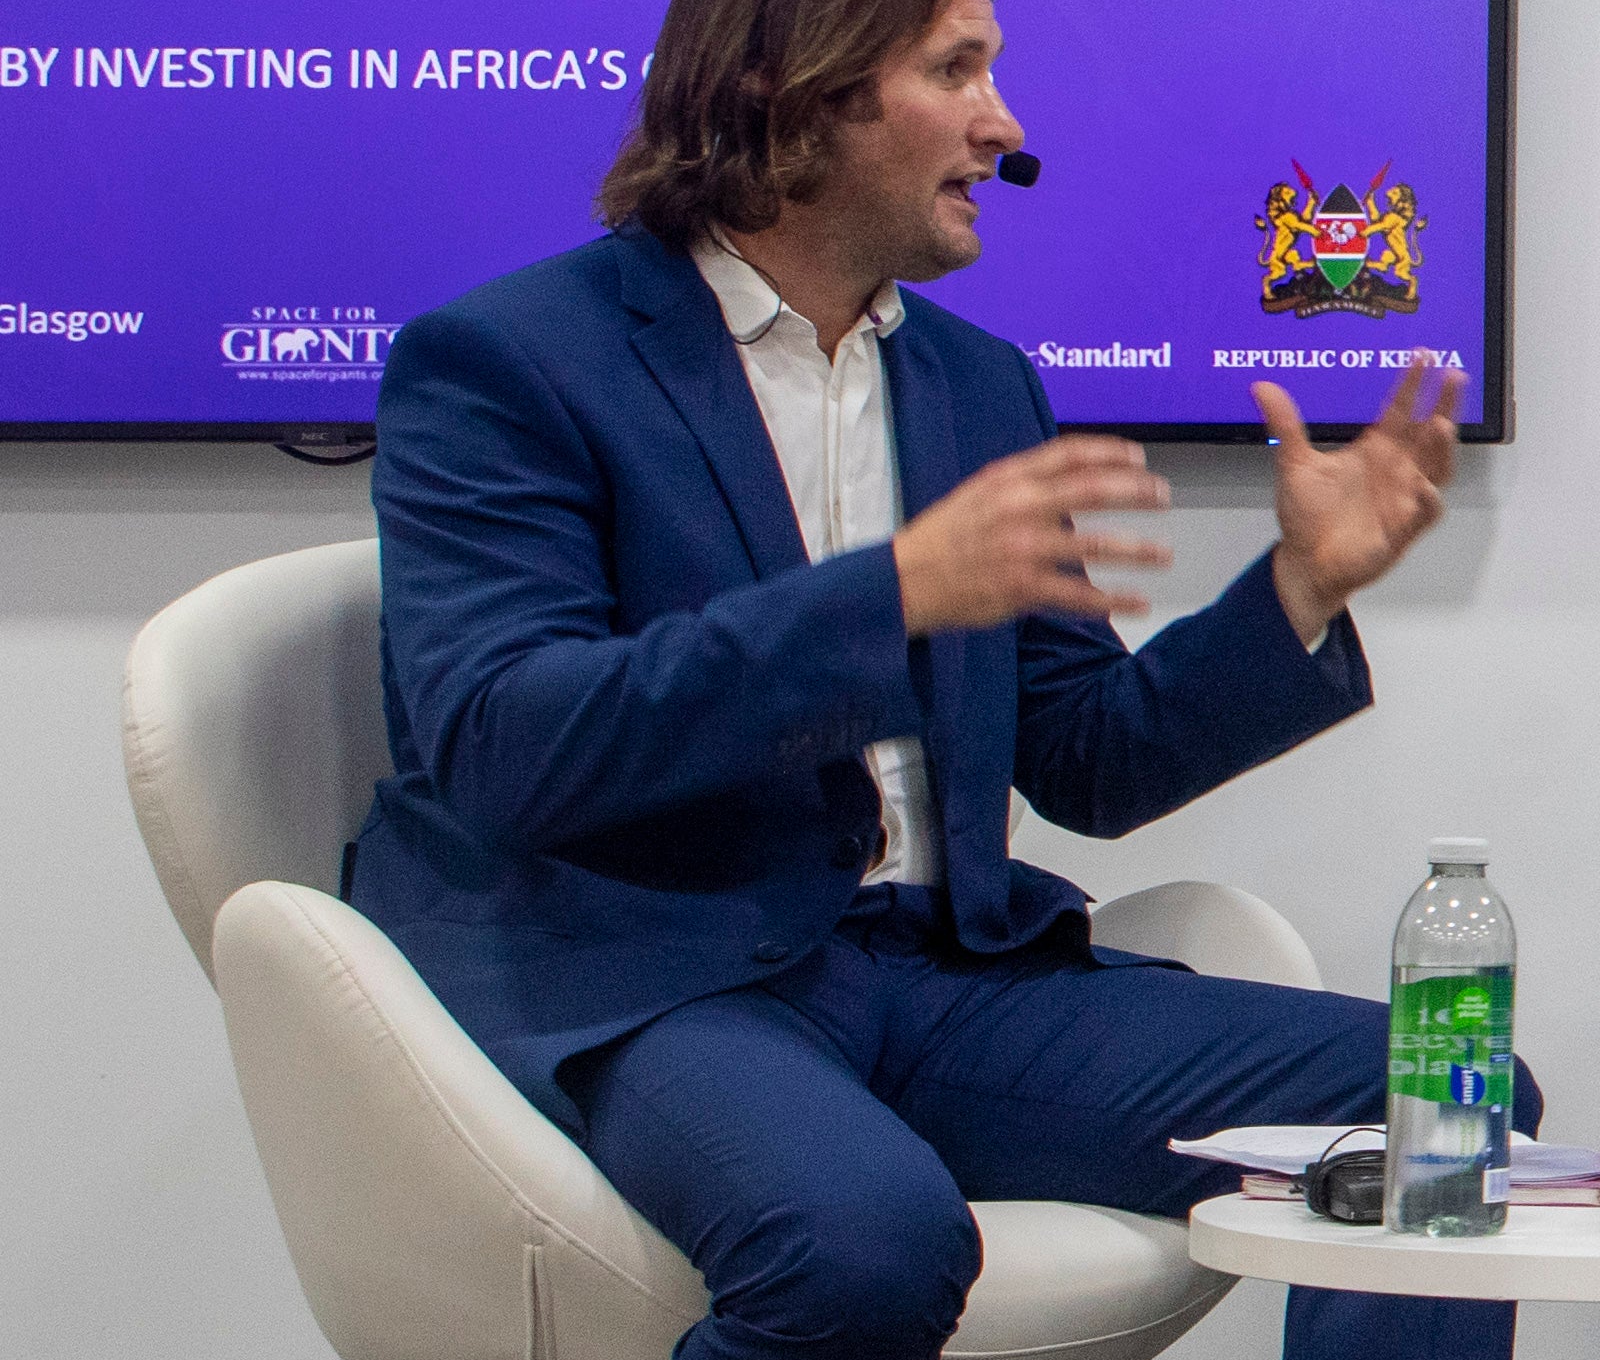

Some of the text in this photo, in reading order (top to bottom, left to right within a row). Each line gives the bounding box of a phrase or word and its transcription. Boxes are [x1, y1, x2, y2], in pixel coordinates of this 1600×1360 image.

[1, 47, 59, 87] BY
[74, 47, 333, 89] INVESTING
[350, 49, 398, 89] IN
[412, 47, 628, 91] AFRICA’S
[0, 302, 144, 342] Glasgow
[252, 306, 376, 321] SPACE FOR
[1038, 341, 1171, 367] Standard
[1213, 349, 1336, 368] REPUBLIC
[1341, 349, 1375, 368] OF
